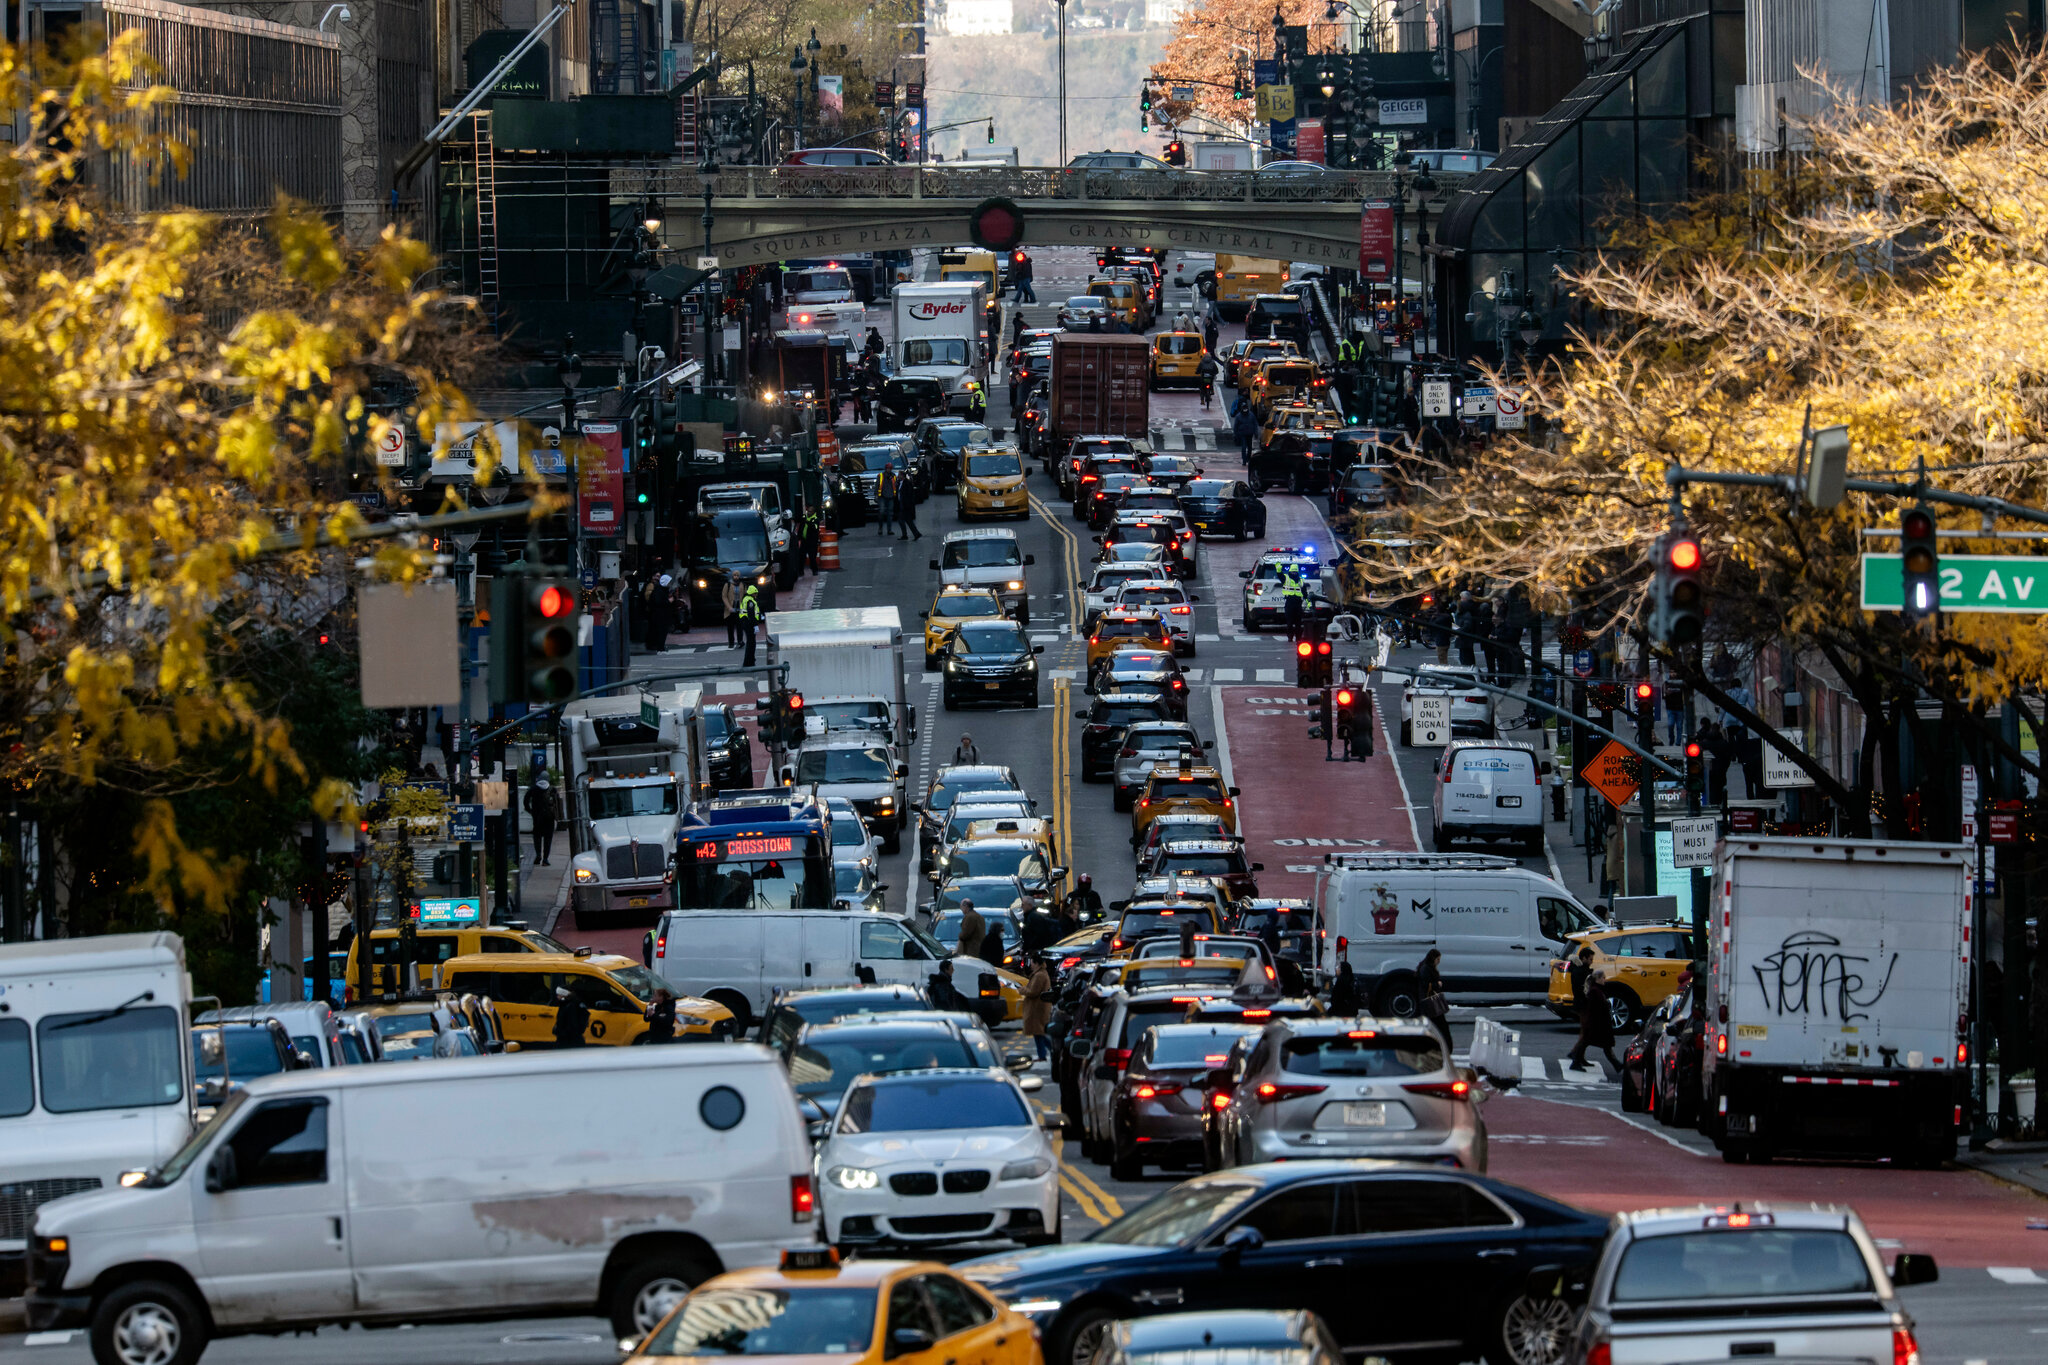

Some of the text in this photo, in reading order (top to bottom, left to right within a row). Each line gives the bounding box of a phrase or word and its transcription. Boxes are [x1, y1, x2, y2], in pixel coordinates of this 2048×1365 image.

[1381, 101, 1424, 112] GEIGER
[753, 233, 842, 256] SQUARE
[860, 227, 931, 243] PLAZA
[1069, 225, 1150, 239] GRAND
[1168, 229, 1274, 250] CENTRAL
[922, 302, 967, 316] Ryder
[361, 496, 377, 504] Ave
[1939, 568, 2035, 600] 2 Av
[1423, 700, 1440, 708] BUS
[1416, 720, 1447, 728] SIGNAL
[1768, 771, 1790, 779] TURN
[1602, 777, 1635, 787] AHEAD
[1674, 823, 1714, 834] RIGHT LANE
[727, 837, 793, 855] CROSSTOWN
[1273, 838, 1388, 847] ONLY
[1683, 838, 1706, 847] MUST
[1675, 853, 1694, 862] TURN
